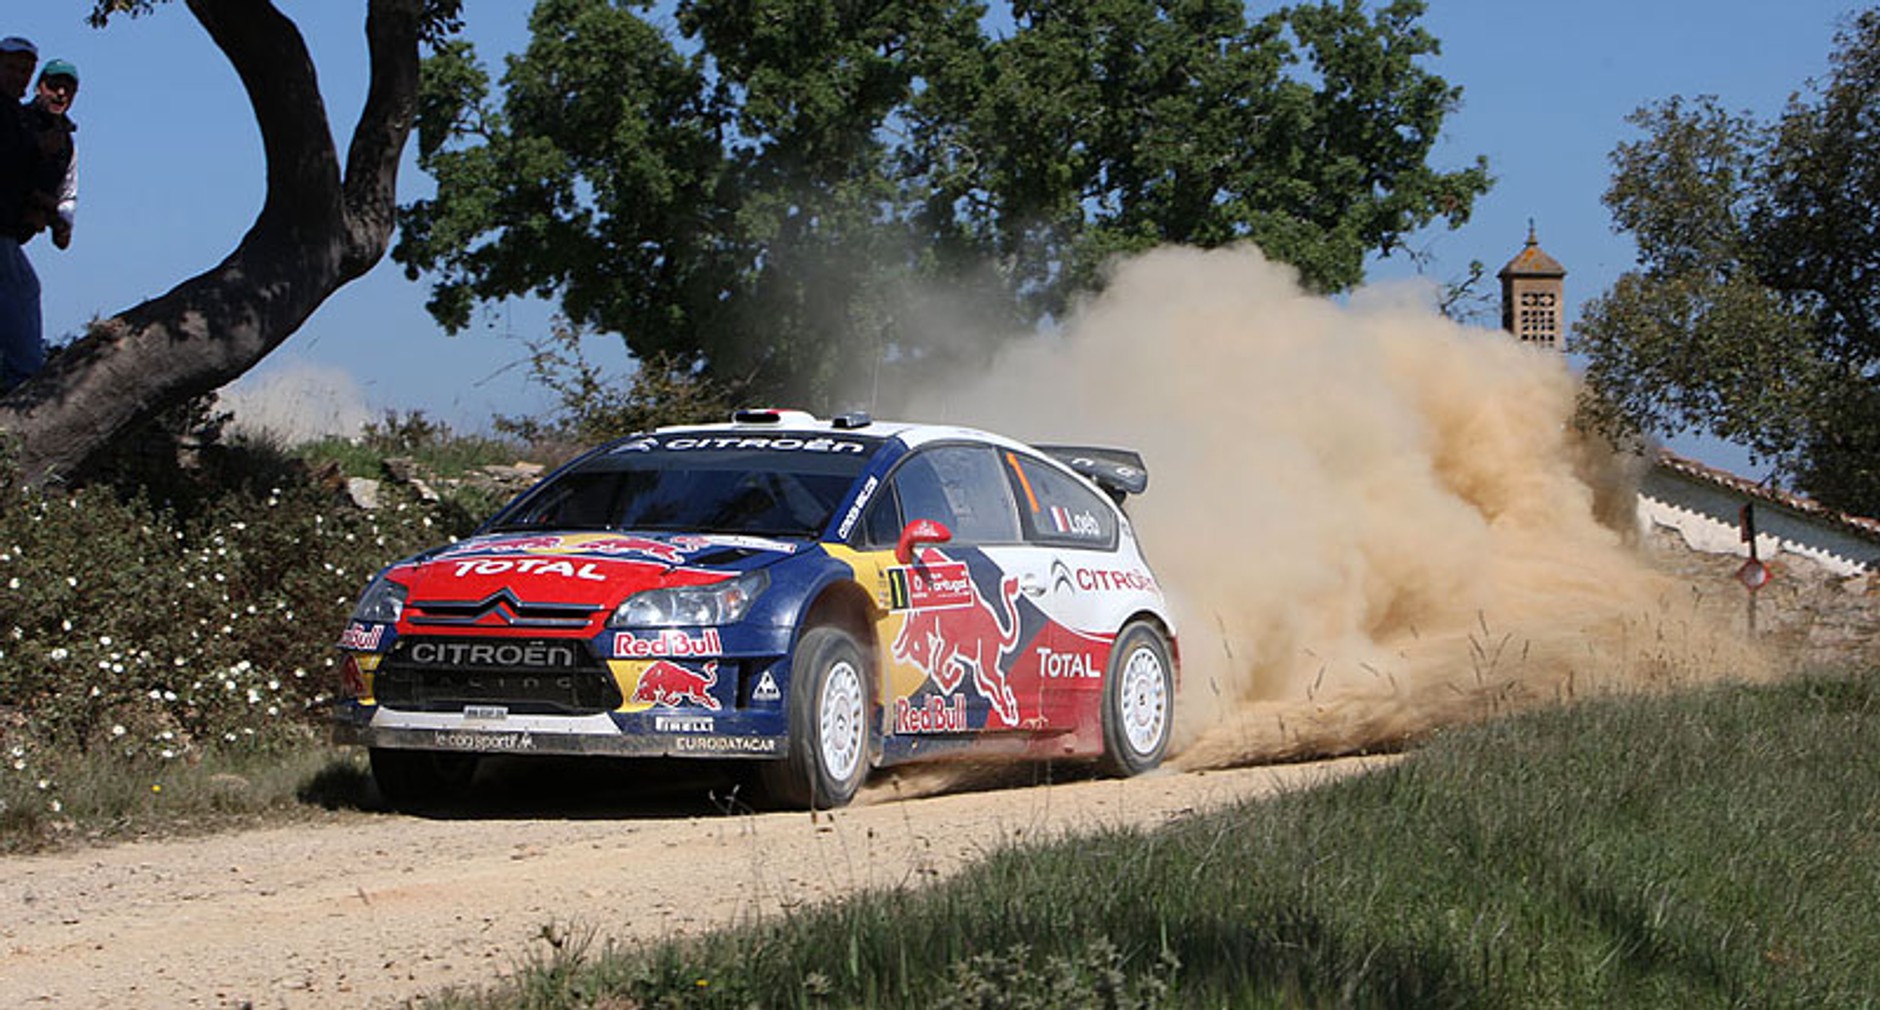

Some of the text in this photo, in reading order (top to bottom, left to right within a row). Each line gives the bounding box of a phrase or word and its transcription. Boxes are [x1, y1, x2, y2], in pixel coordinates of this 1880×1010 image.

[454, 559, 607, 581] TOTAL
[1076, 567, 1158, 593] CITRO
[891, 571, 904, 607] 1
[614, 627, 722, 657] Red Bull
[1036, 647, 1101, 678] TOTAL
[656, 717, 713, 732] PIRELLI
[896, 692, 967, 733] Red Bull
[676, 737, 775, 751] EURODATACAR
